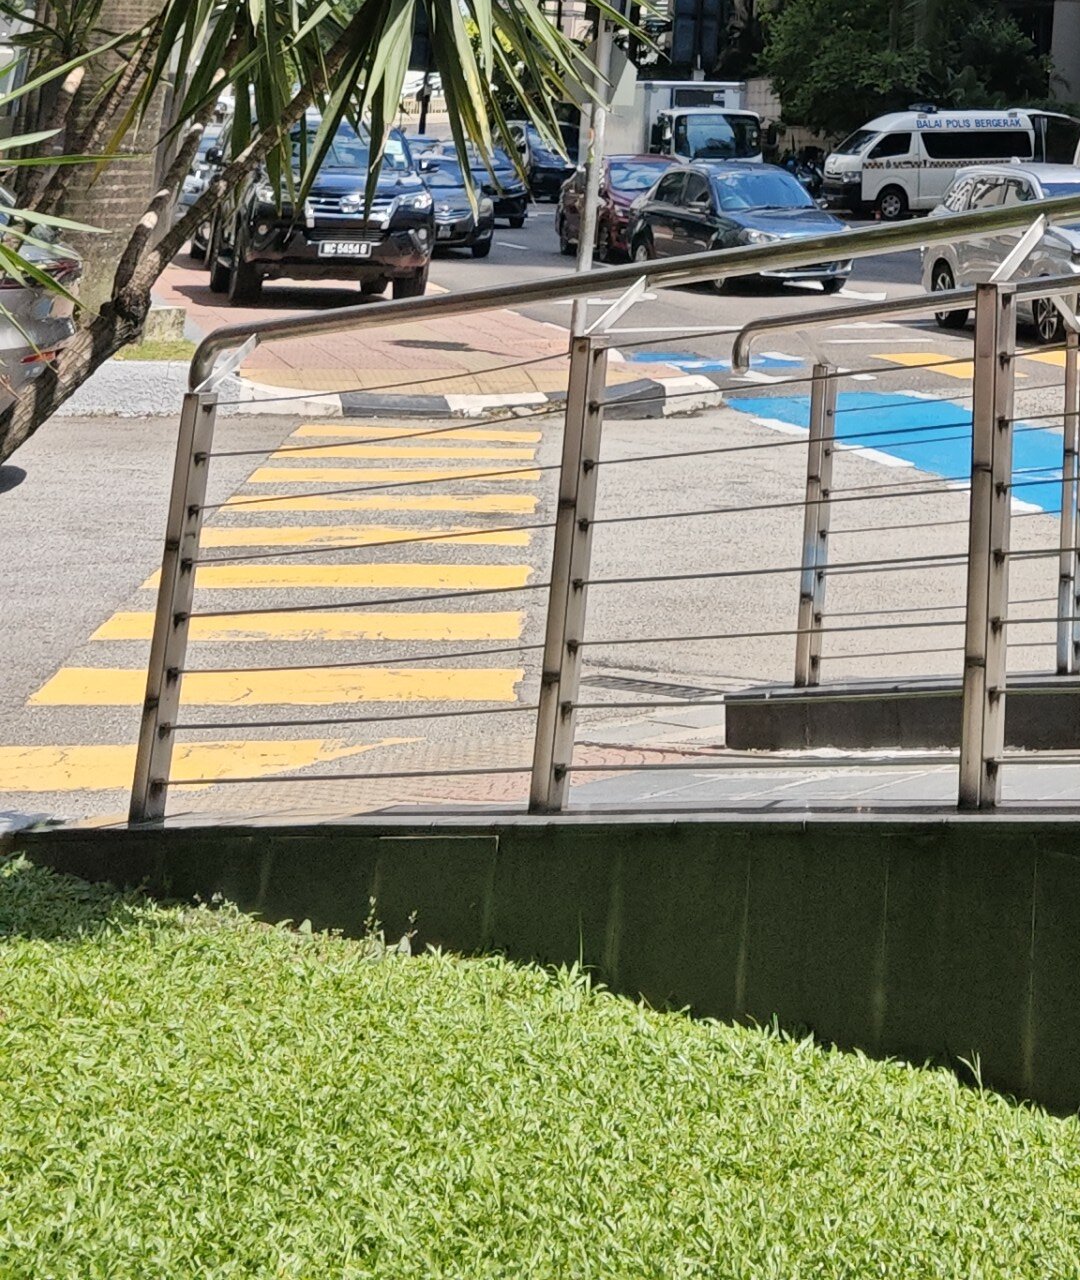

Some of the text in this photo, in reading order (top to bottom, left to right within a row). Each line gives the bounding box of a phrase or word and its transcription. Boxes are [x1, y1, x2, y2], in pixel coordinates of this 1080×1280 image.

[916, 118, 1021, 129] BALAI POLIS BERGERAK
